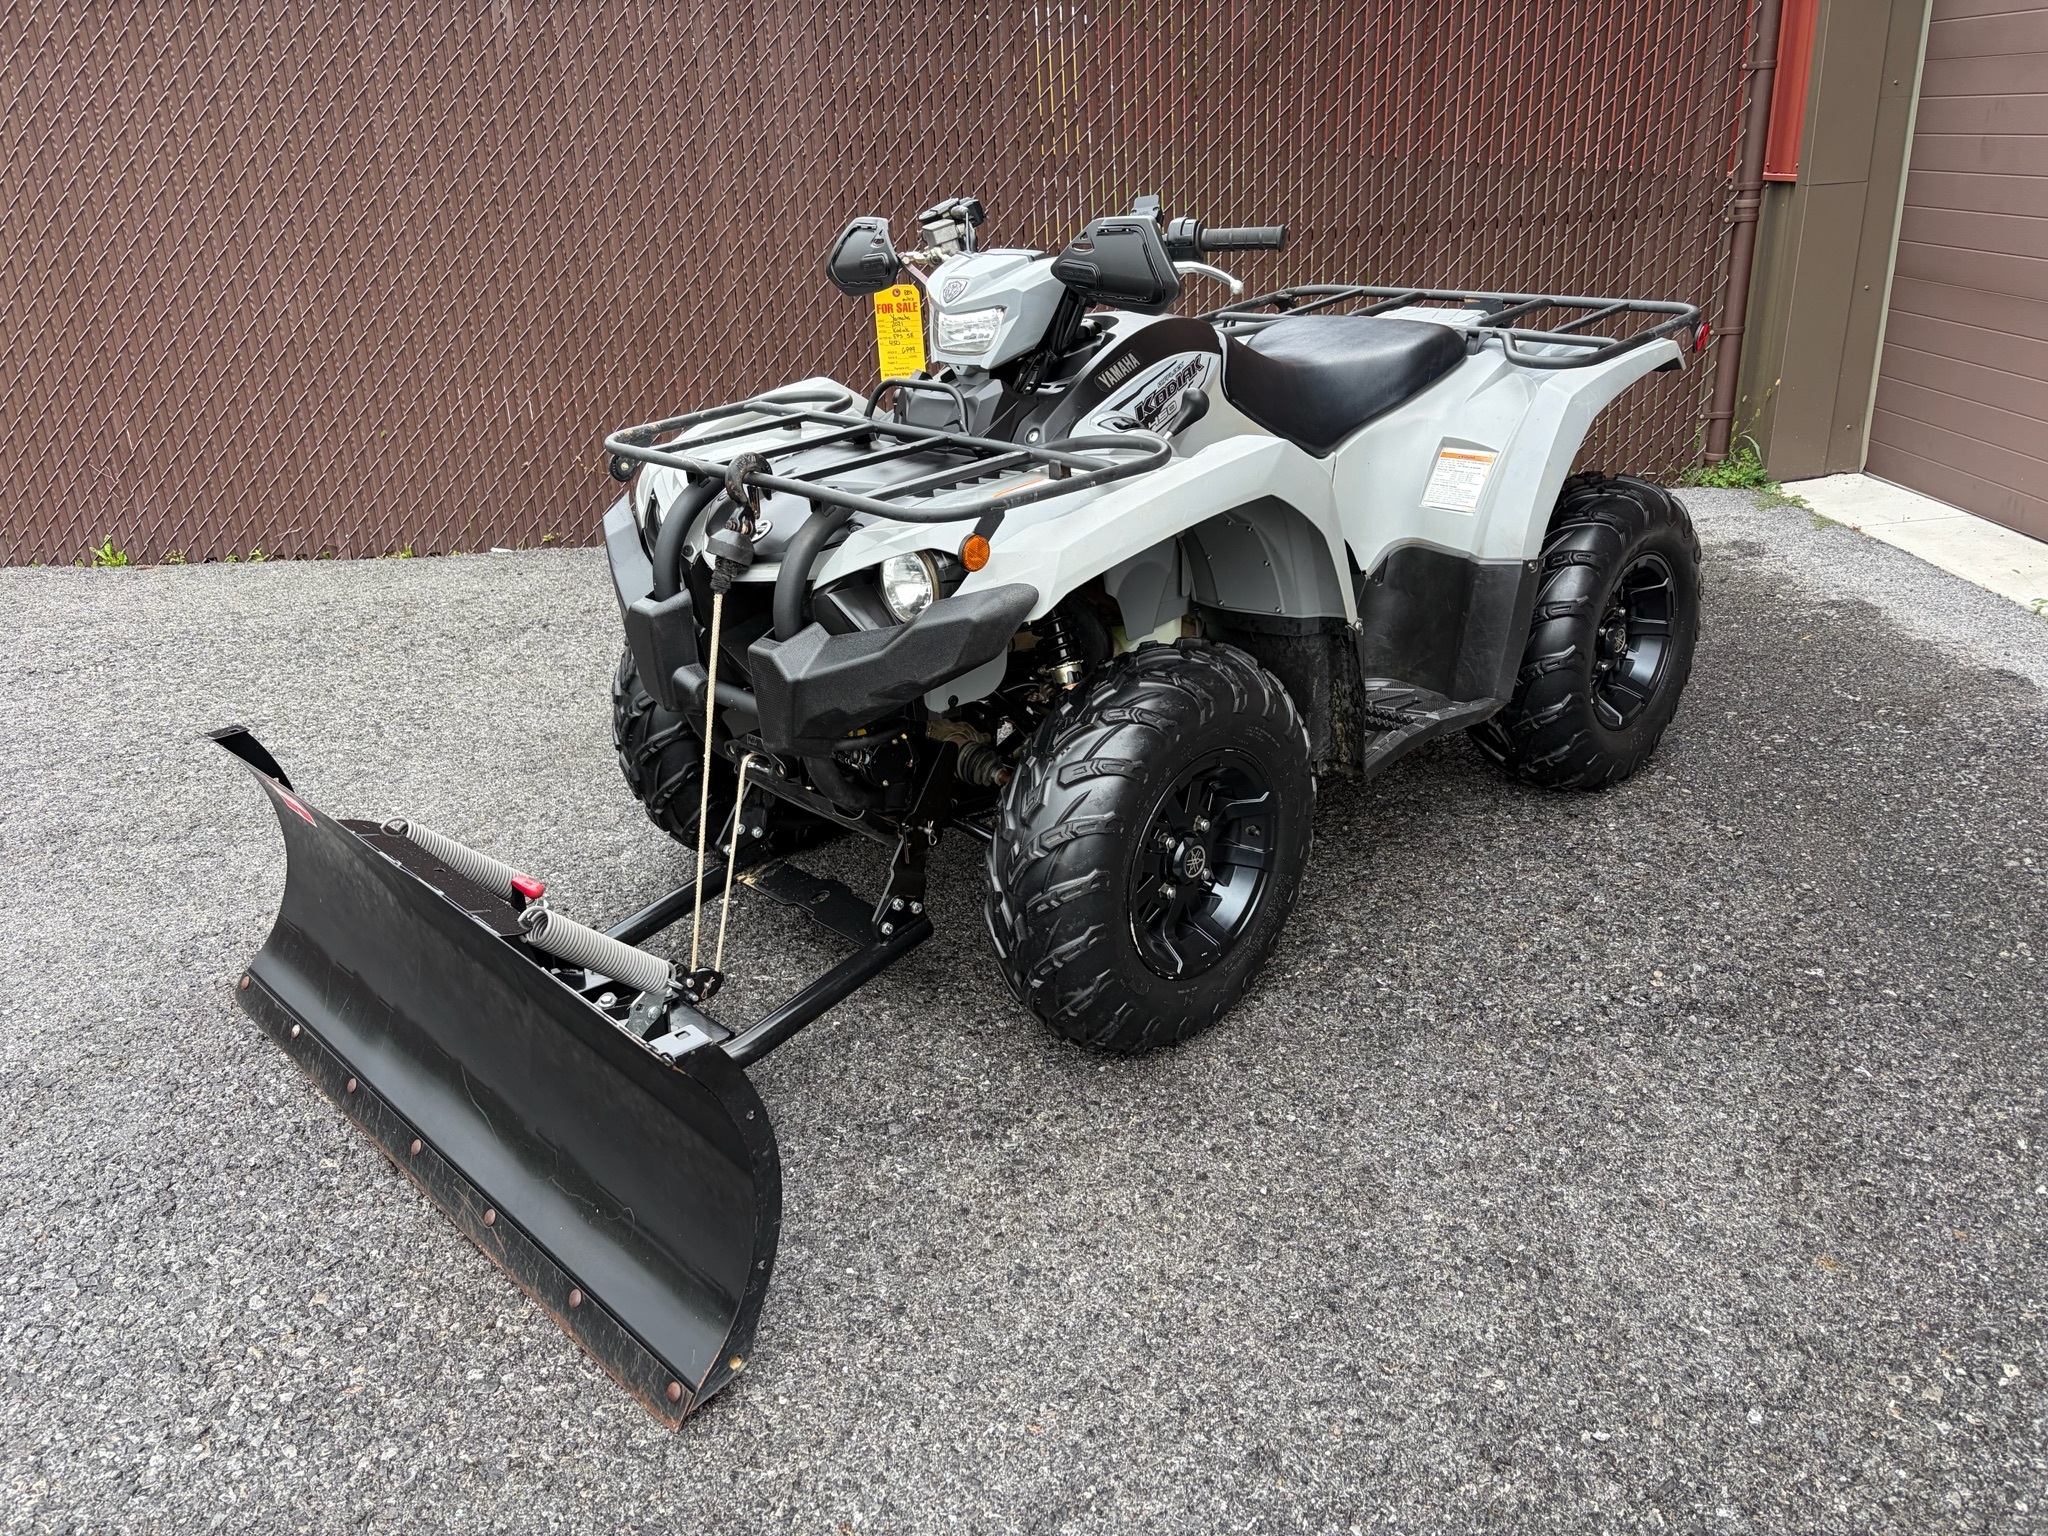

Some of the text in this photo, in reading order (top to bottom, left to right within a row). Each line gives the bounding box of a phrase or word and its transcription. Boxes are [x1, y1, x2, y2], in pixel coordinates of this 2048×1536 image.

[876, 302, 918, 314] FOR SALE
[1098, 352, 1141, 388] YAMAHA
[1134, 353, 1205, 422] KODIAK
[1148, 400, 1178, 429] 450
